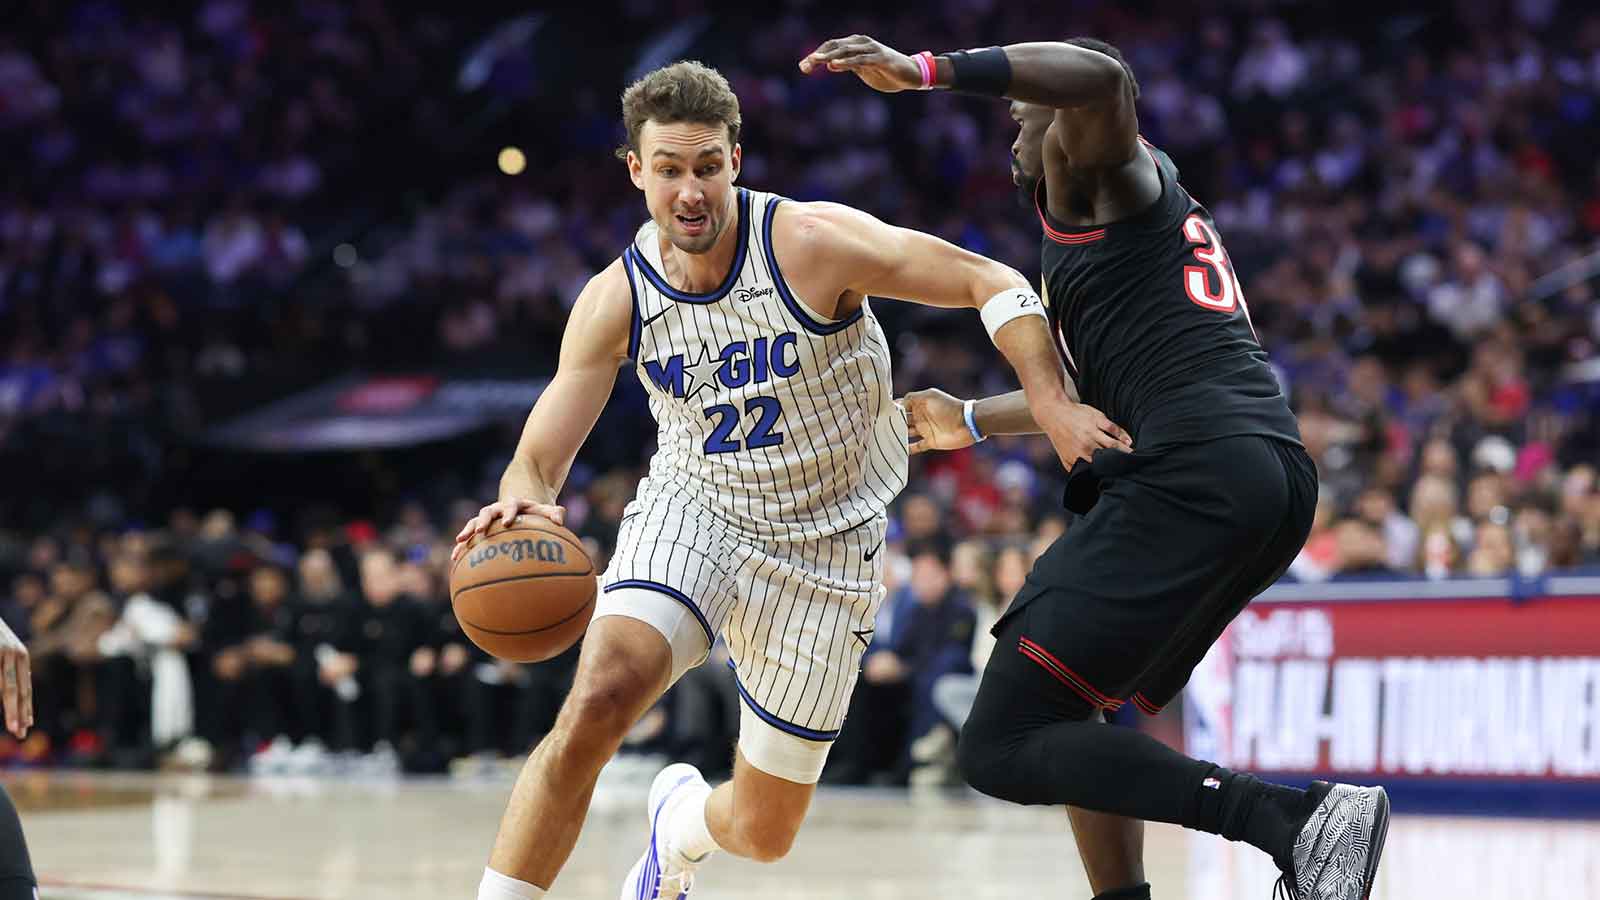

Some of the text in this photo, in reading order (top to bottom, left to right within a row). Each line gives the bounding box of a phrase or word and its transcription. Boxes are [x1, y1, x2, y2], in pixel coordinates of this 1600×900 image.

[734, 286, 774, 303] Disney
[1183, 213, 1248, 330] 3
[703, 395, 784, 456] 22
[469, 538, 567, 569] Wilson
